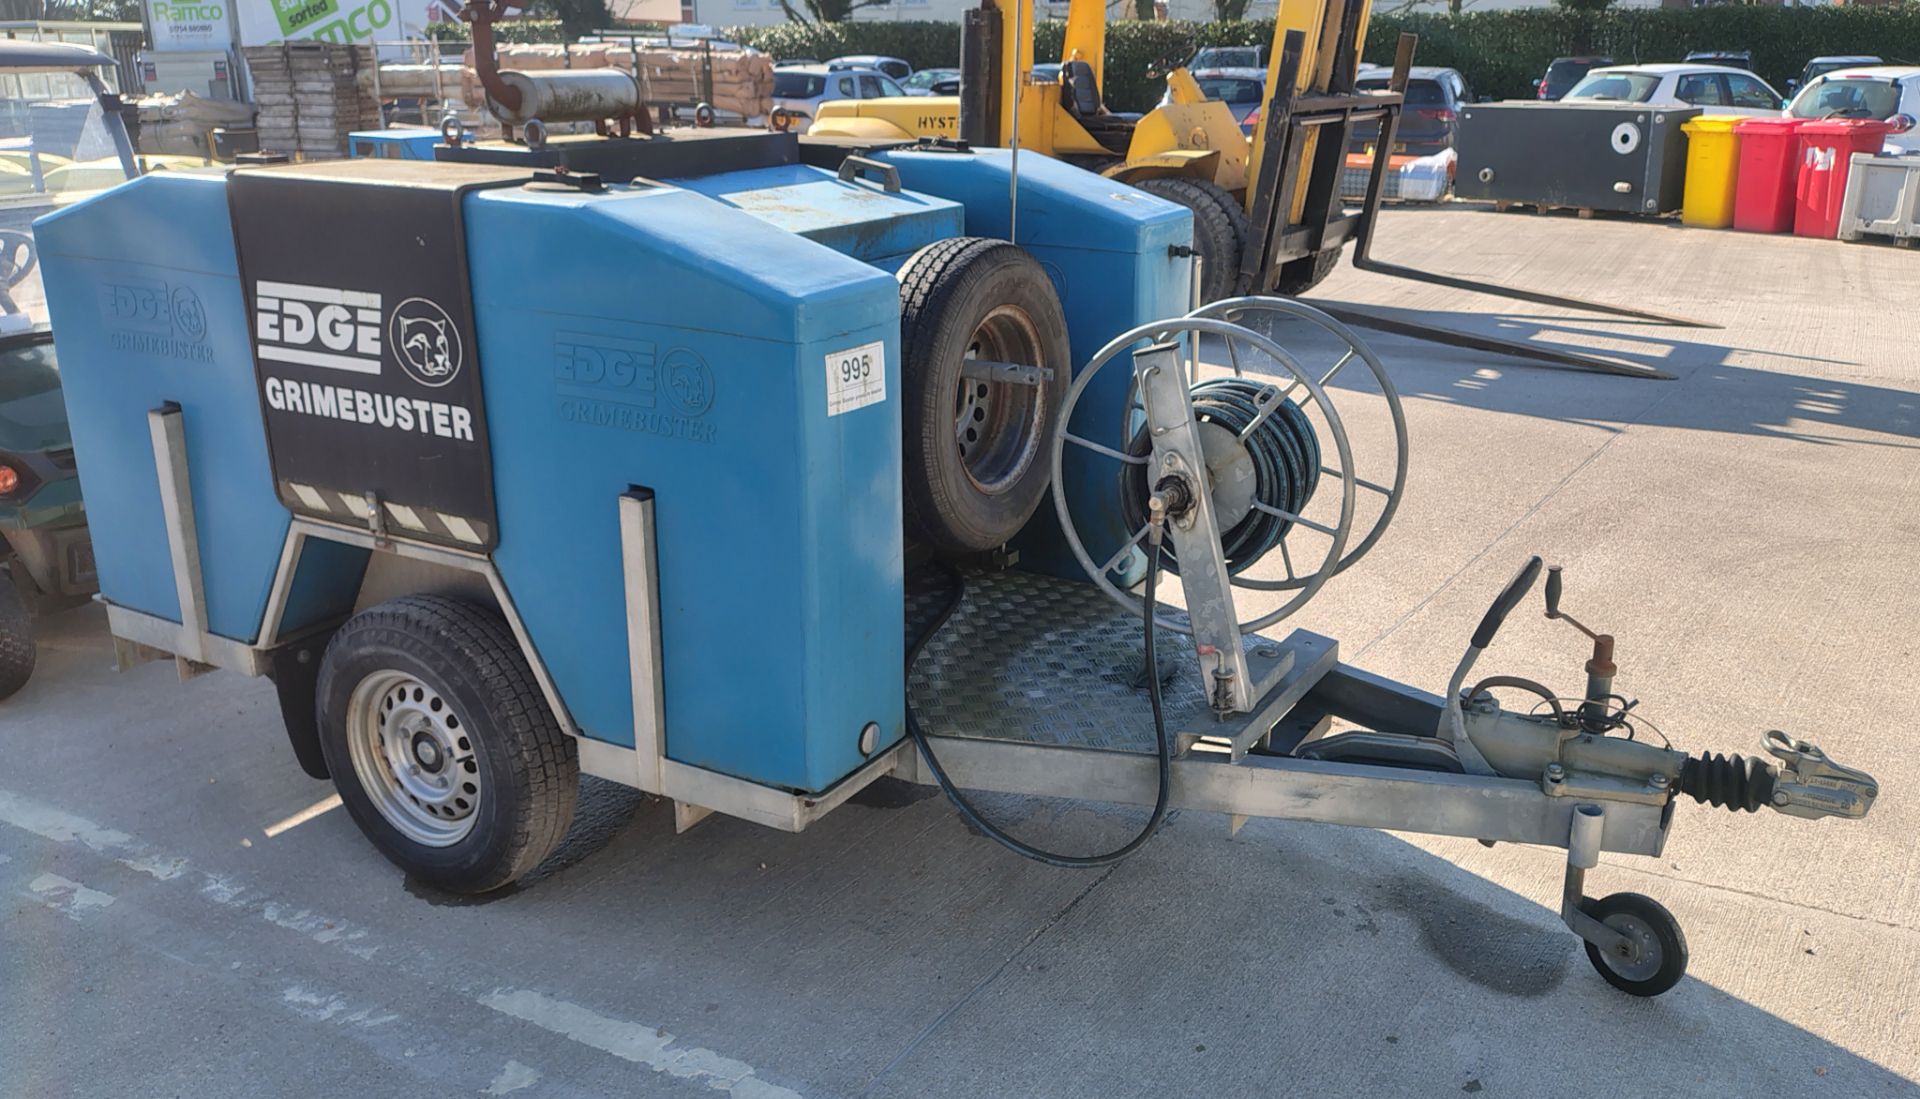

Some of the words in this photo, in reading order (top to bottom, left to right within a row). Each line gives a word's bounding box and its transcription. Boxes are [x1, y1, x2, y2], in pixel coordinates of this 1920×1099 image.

[153, 2, 223, 21] Ramco
[288, 0, 328, 28] sorted
[918, 116, 960, 129] HYST
[257, 296, 381, 356] EDGE
[841, 354, 870, 383] 995
[265, 376, 474, 441] GRIMEBUSTER
[558, 400, 718, 443] GRIMEBUSTER
